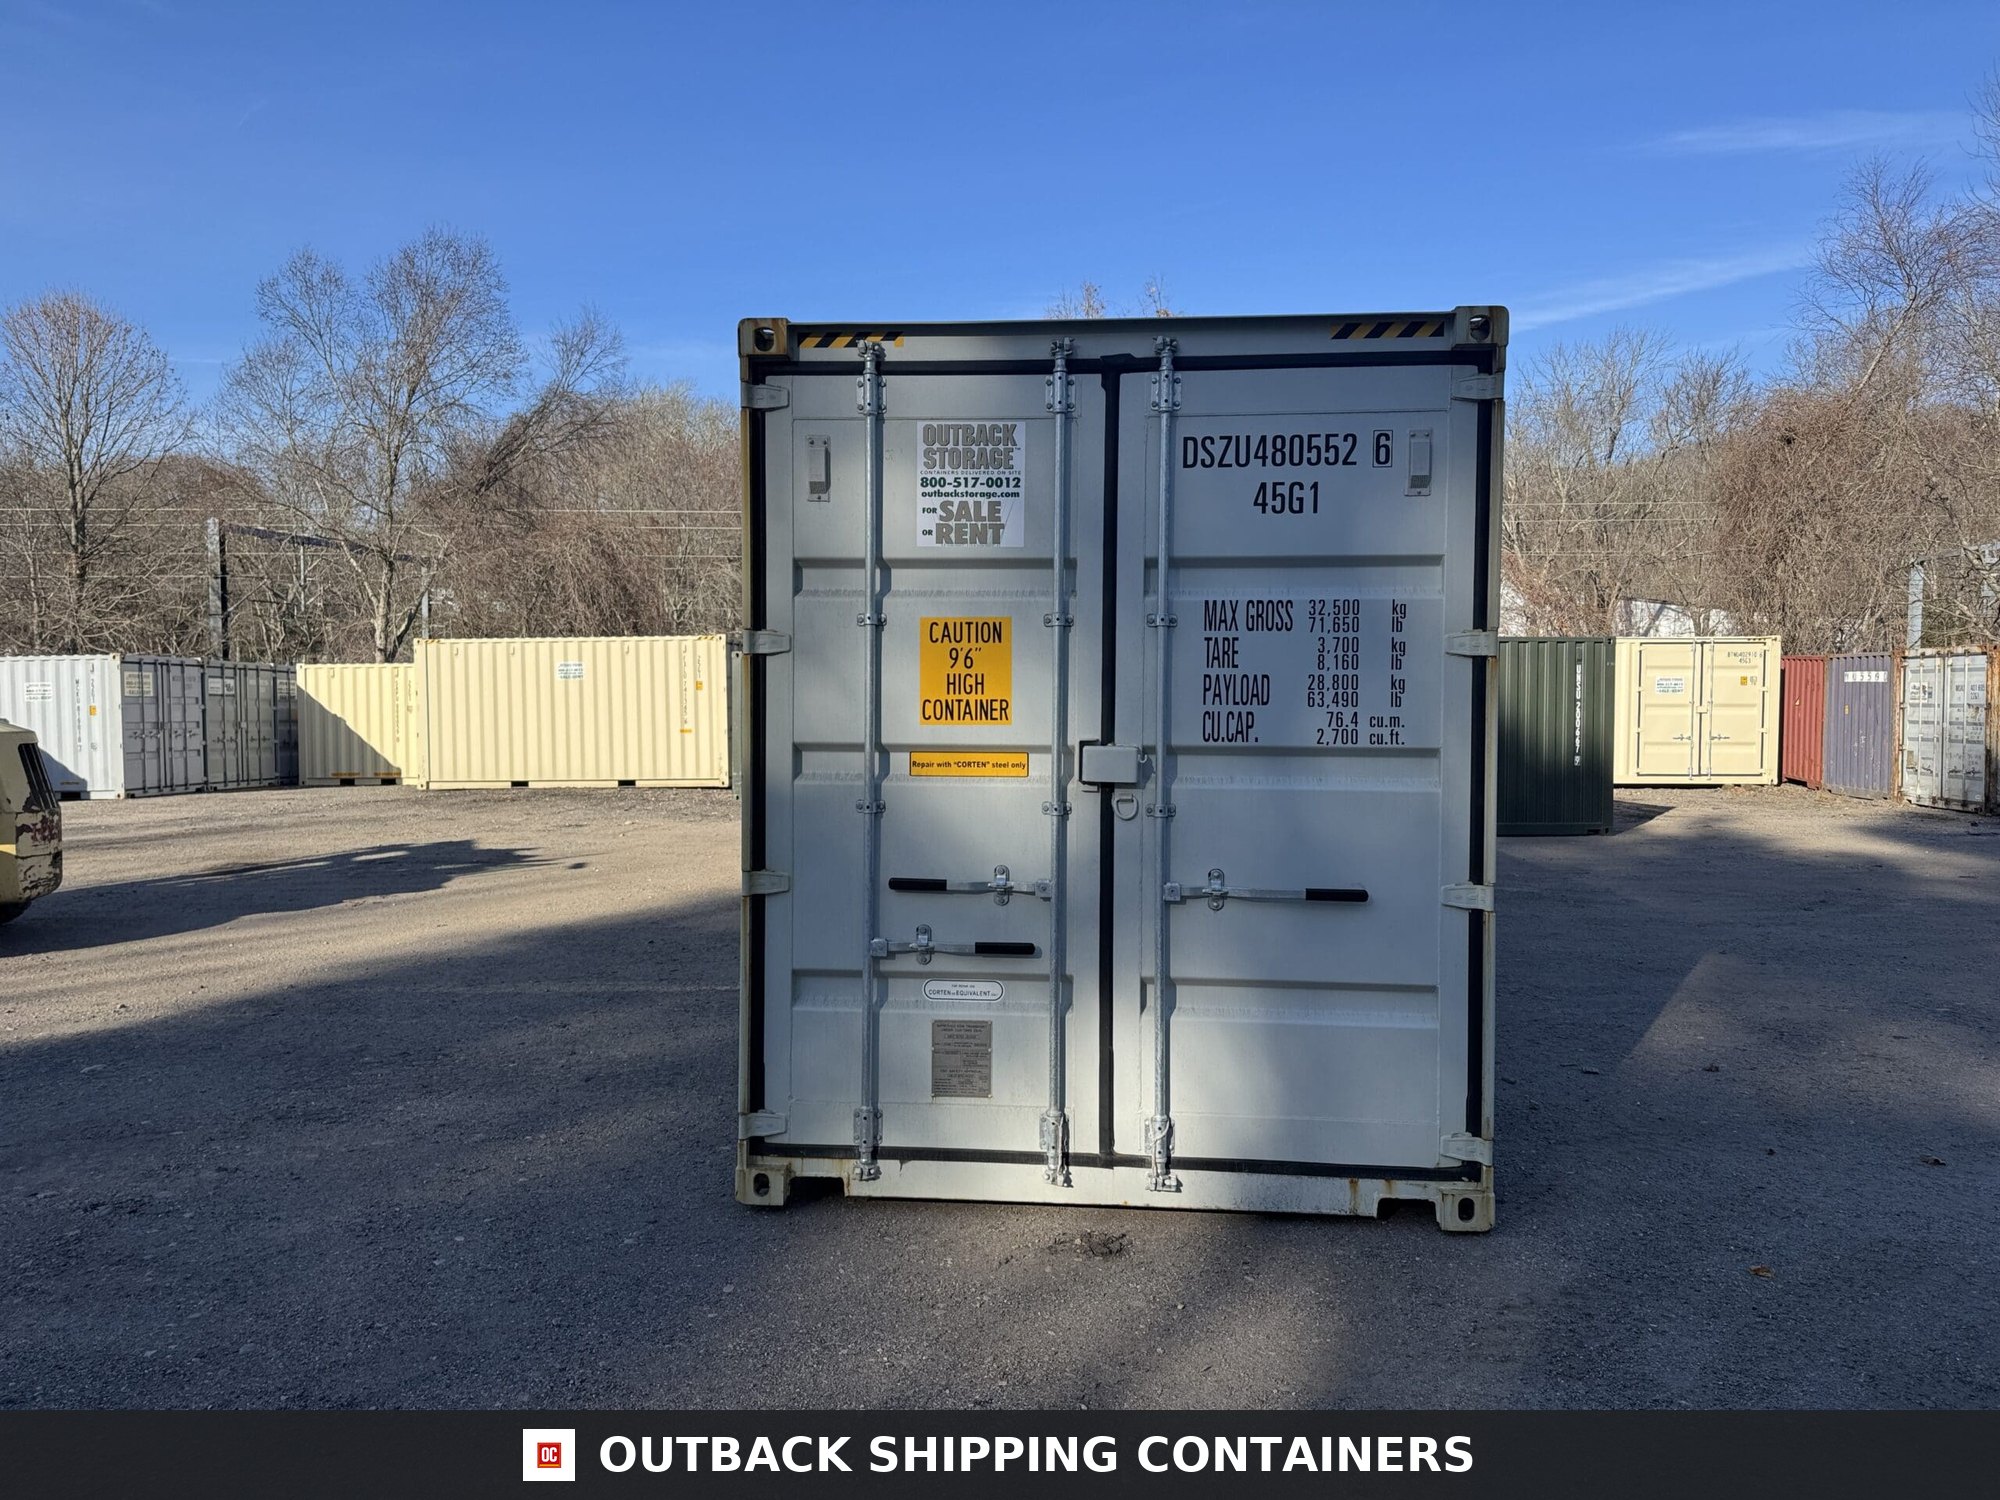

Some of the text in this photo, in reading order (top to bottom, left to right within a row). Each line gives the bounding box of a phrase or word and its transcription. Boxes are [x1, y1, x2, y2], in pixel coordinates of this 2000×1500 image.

[922, 423, 1018, 447] OUTBACK
[923, 447, 1014, 470] STORAGE
[1182, 432, 1391, 469] DSZU480552 6
[920, 477, 1021, 489] 800-517-0012
[921, 489, 1020, 499] outbackstorage.com
[1253, 481, 1319, 515] 45G1
[922, 501, 1002, 522] FOR SALE
[935, 523, 1005, 545] RENT
[1203, 599, 1407, 632] MAX GROSS 32,500 kg
[1308, 616, 1403, 634] 71,650 lb
[929, 622, 1002, 644] CAUTION
[1204, 637, 1406, 669] TARE 3,700 kg
[1317, 654, 1402, 672] 8,160 lb
[946, 674, 985, 695] HIGH
[1202, 674, 1405, 706] PAYLOAD 28,800 kg
[922, 699, 1009, 721] CONTAINER
[1307, 692, 1402, 709] 63,490 lb
[1202, 711, 1406, 743] CU.CAP. 76.4 cu.m.
[1316, 729, 1405, 746] 2,700 cu.ft.
[912, 760, 1026, 770] Repair with "CORTEN" steel only
